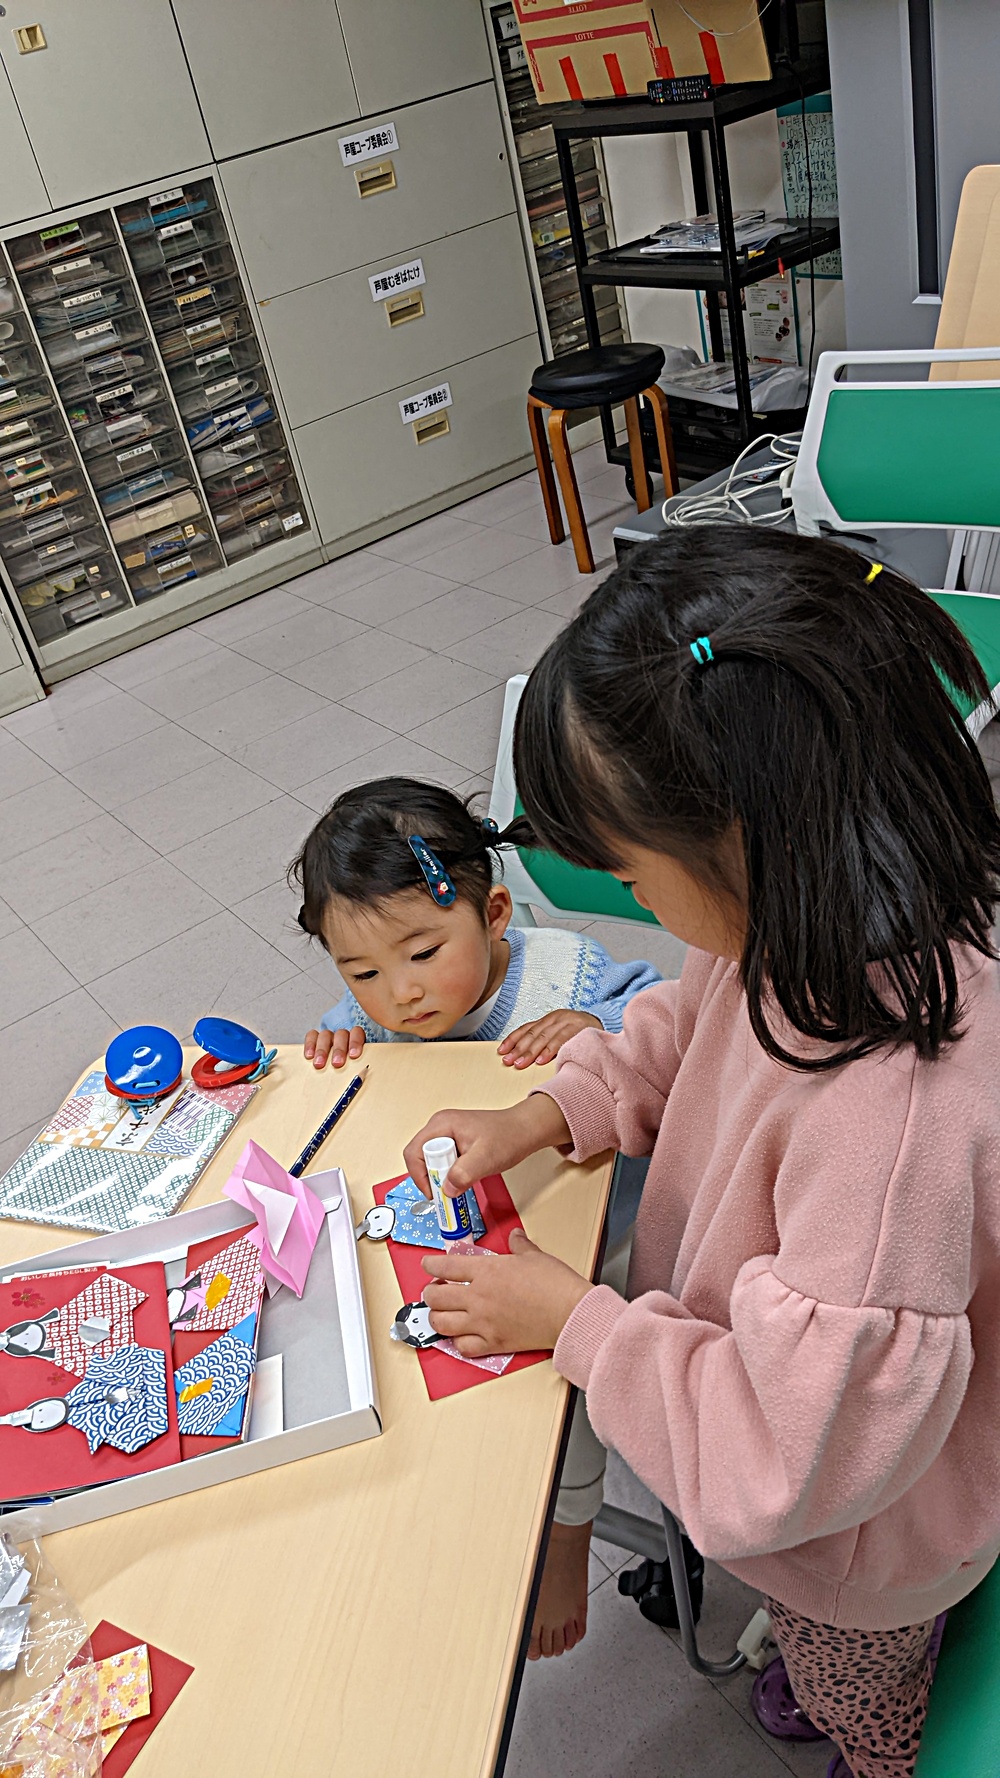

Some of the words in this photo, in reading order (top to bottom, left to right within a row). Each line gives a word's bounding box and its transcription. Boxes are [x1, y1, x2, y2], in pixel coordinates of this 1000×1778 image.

[568, 4, 588, 14] LOTTE
[574, 32, 594, 42] LOTTE
[343, 129, 394, 158] 芦屋コープ委員会①
[373, 266, 420, 294] 芦屋むぎばたけ
[403, 389, 448, 417] 芦屋コープ委員会②
[420, 847, 439, 876] familiar
[458, 1207, 468, 1229] GLUE
